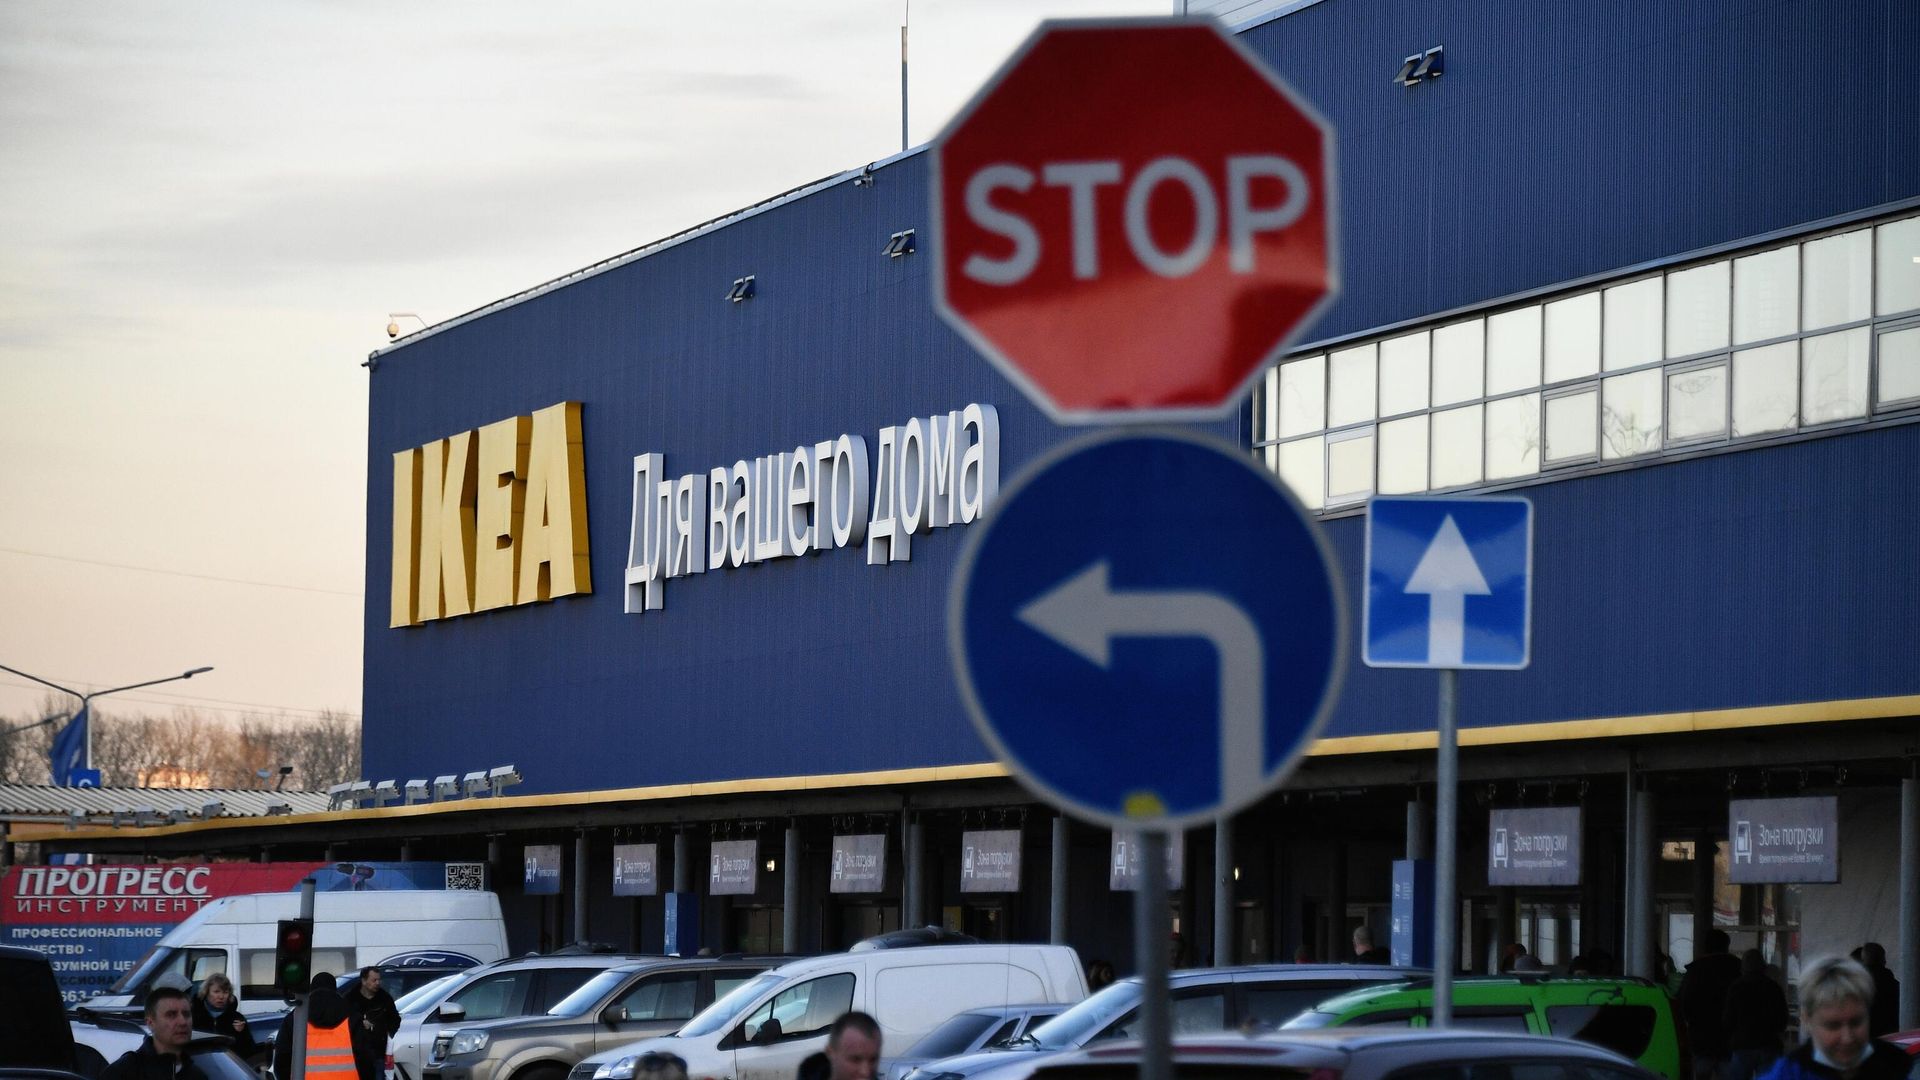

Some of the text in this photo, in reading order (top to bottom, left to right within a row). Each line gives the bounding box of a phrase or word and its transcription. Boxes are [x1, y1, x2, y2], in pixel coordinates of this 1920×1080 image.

[962, 153, 1311, 286] STOP
[389, 401, 593, 629] IKEA
[624, 402, 1001, 614] Для вашего дома
[1759, 824, 1824, 852] Зона погрузки
[17, 867, 210, 896] ПРОГРЕСС
[17, 899, 207, 913] ИНСТРУМЕНТ
[12, 927, 163, 939] ПРОФЕССИОНАЛЬНОЕ
